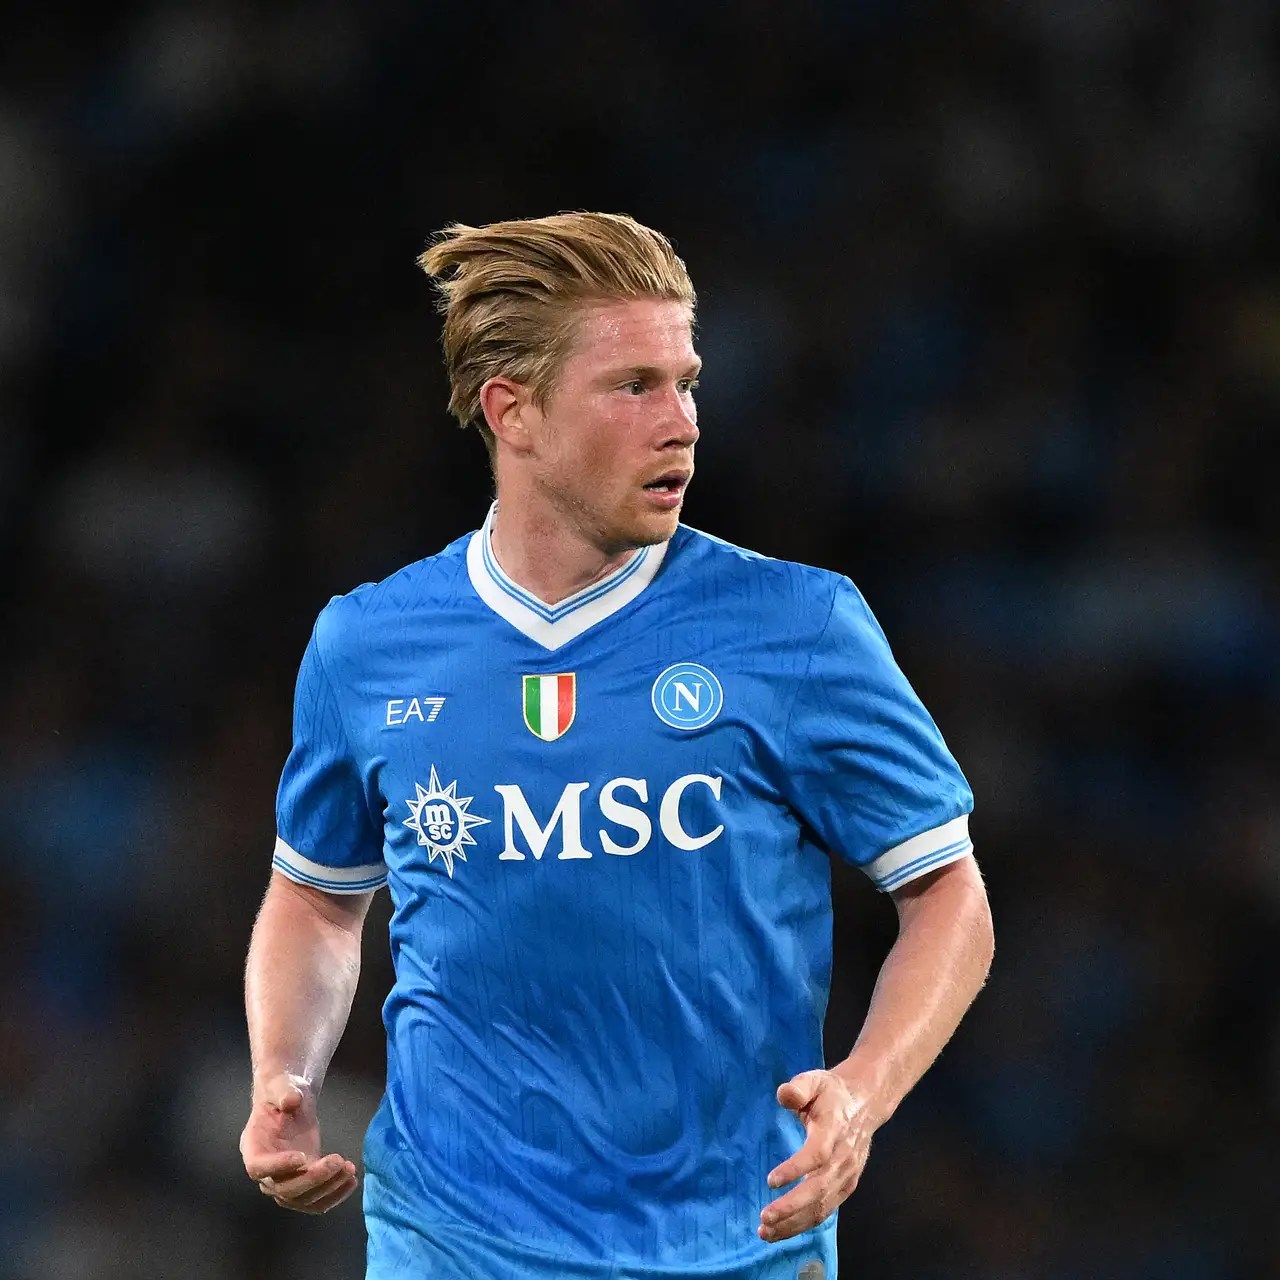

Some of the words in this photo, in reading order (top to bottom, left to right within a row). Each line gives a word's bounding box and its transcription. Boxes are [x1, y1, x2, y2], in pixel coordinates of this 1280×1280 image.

[386, 697, 447, 726] EA7
[672, 682, 704, 713] N
[494, 774, 724, 861] MSC
